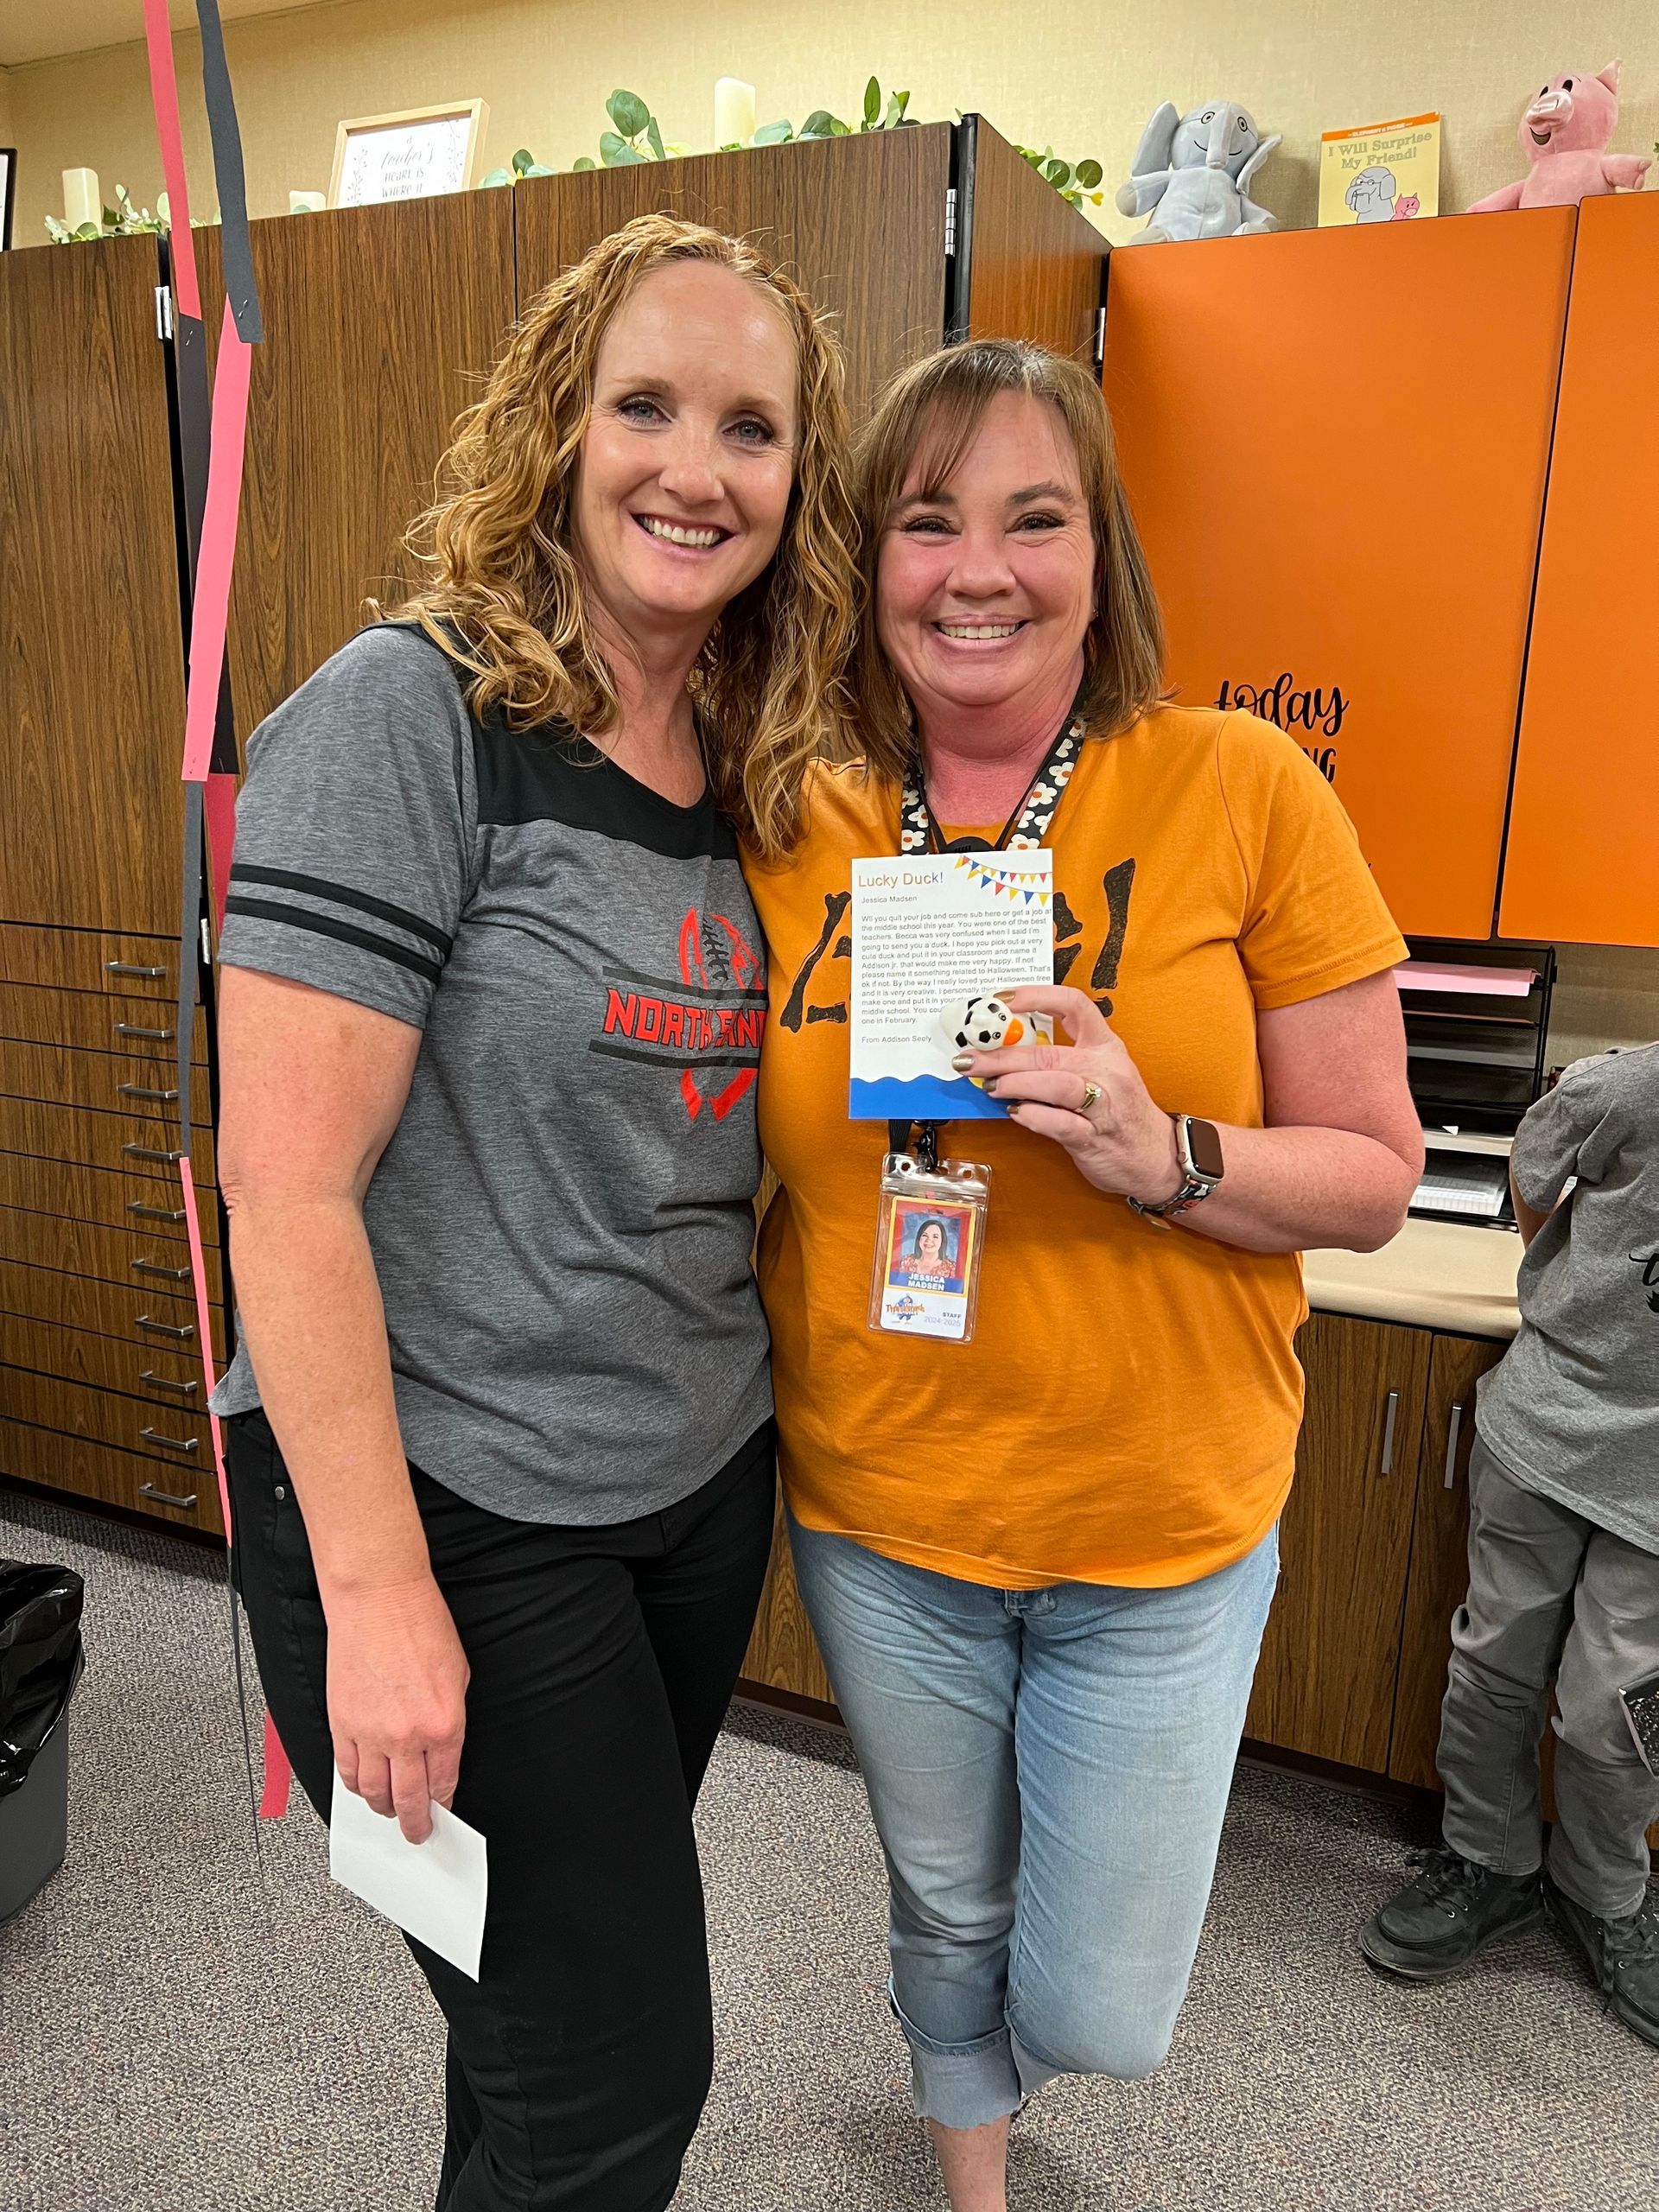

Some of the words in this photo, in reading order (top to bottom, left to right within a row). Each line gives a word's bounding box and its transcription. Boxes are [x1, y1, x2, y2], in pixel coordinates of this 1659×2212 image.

[1328, 147, 1334, 156] I
[1338, 142, 1367, 156] Will
[1372, 132, 1432, 152] Surprise
[1341, 158, 1362, 169] My
[1367, 147, 1417, 166] Friend!
[1214, 672, 1350, 737] today
[859, 874, 898, 888] Lucky
[903, 872, 944, 885] Duck!
[602, 988, 713, 1050] NORTH
[908, 1273, 945, 1283] JESSICA
[908, 1281, 944, 1291] MADSEN
[924, 1316, 961, 1326] 2024-2025
